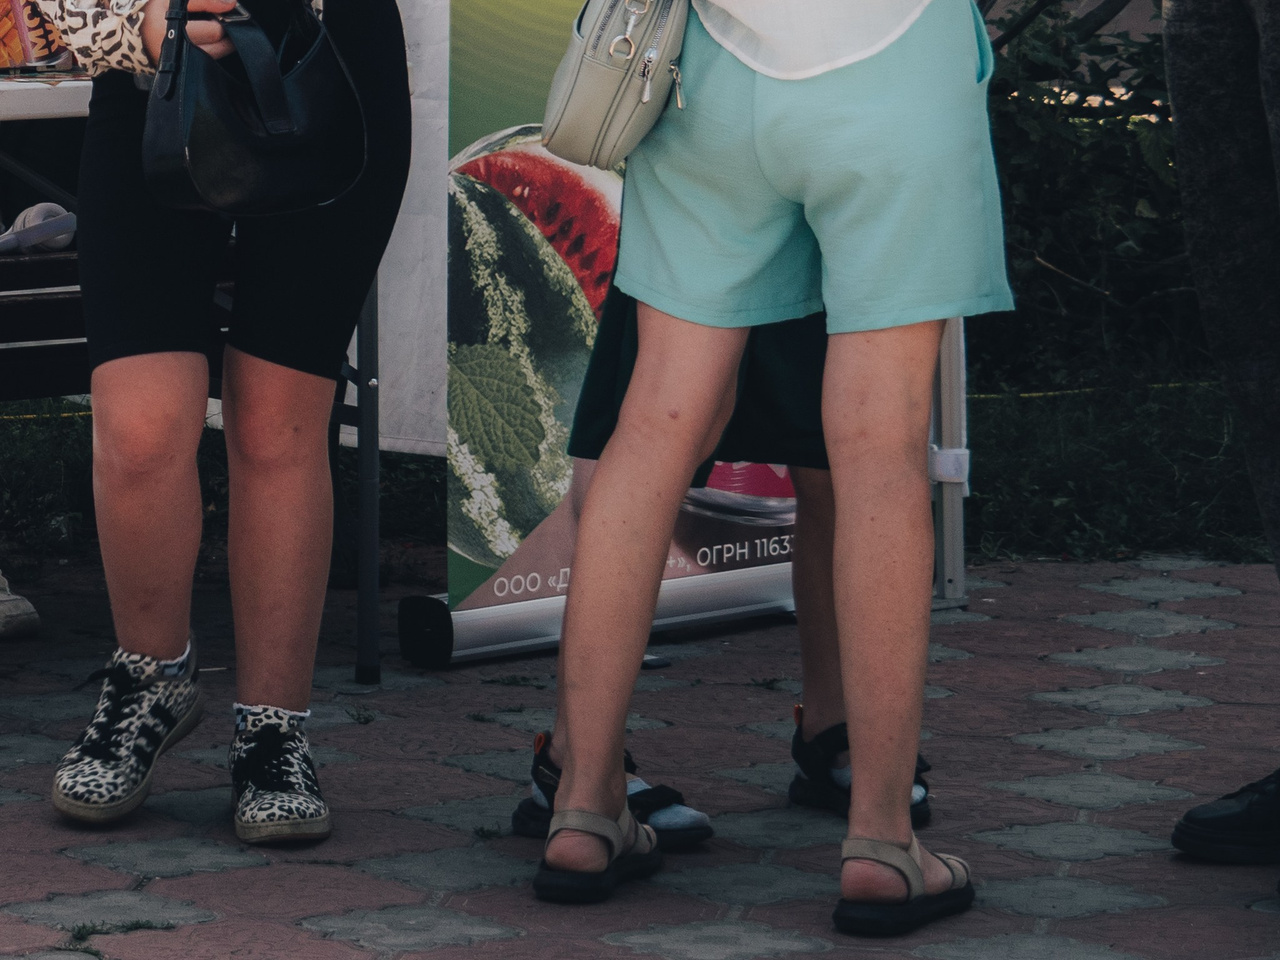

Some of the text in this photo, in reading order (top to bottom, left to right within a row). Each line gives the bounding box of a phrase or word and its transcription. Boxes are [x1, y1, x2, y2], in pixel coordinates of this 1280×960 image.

[493, 572, 541, 597] ООО
[696, 541, 749, 567] ОГРН
[754, 534, 795, 558] 1163
